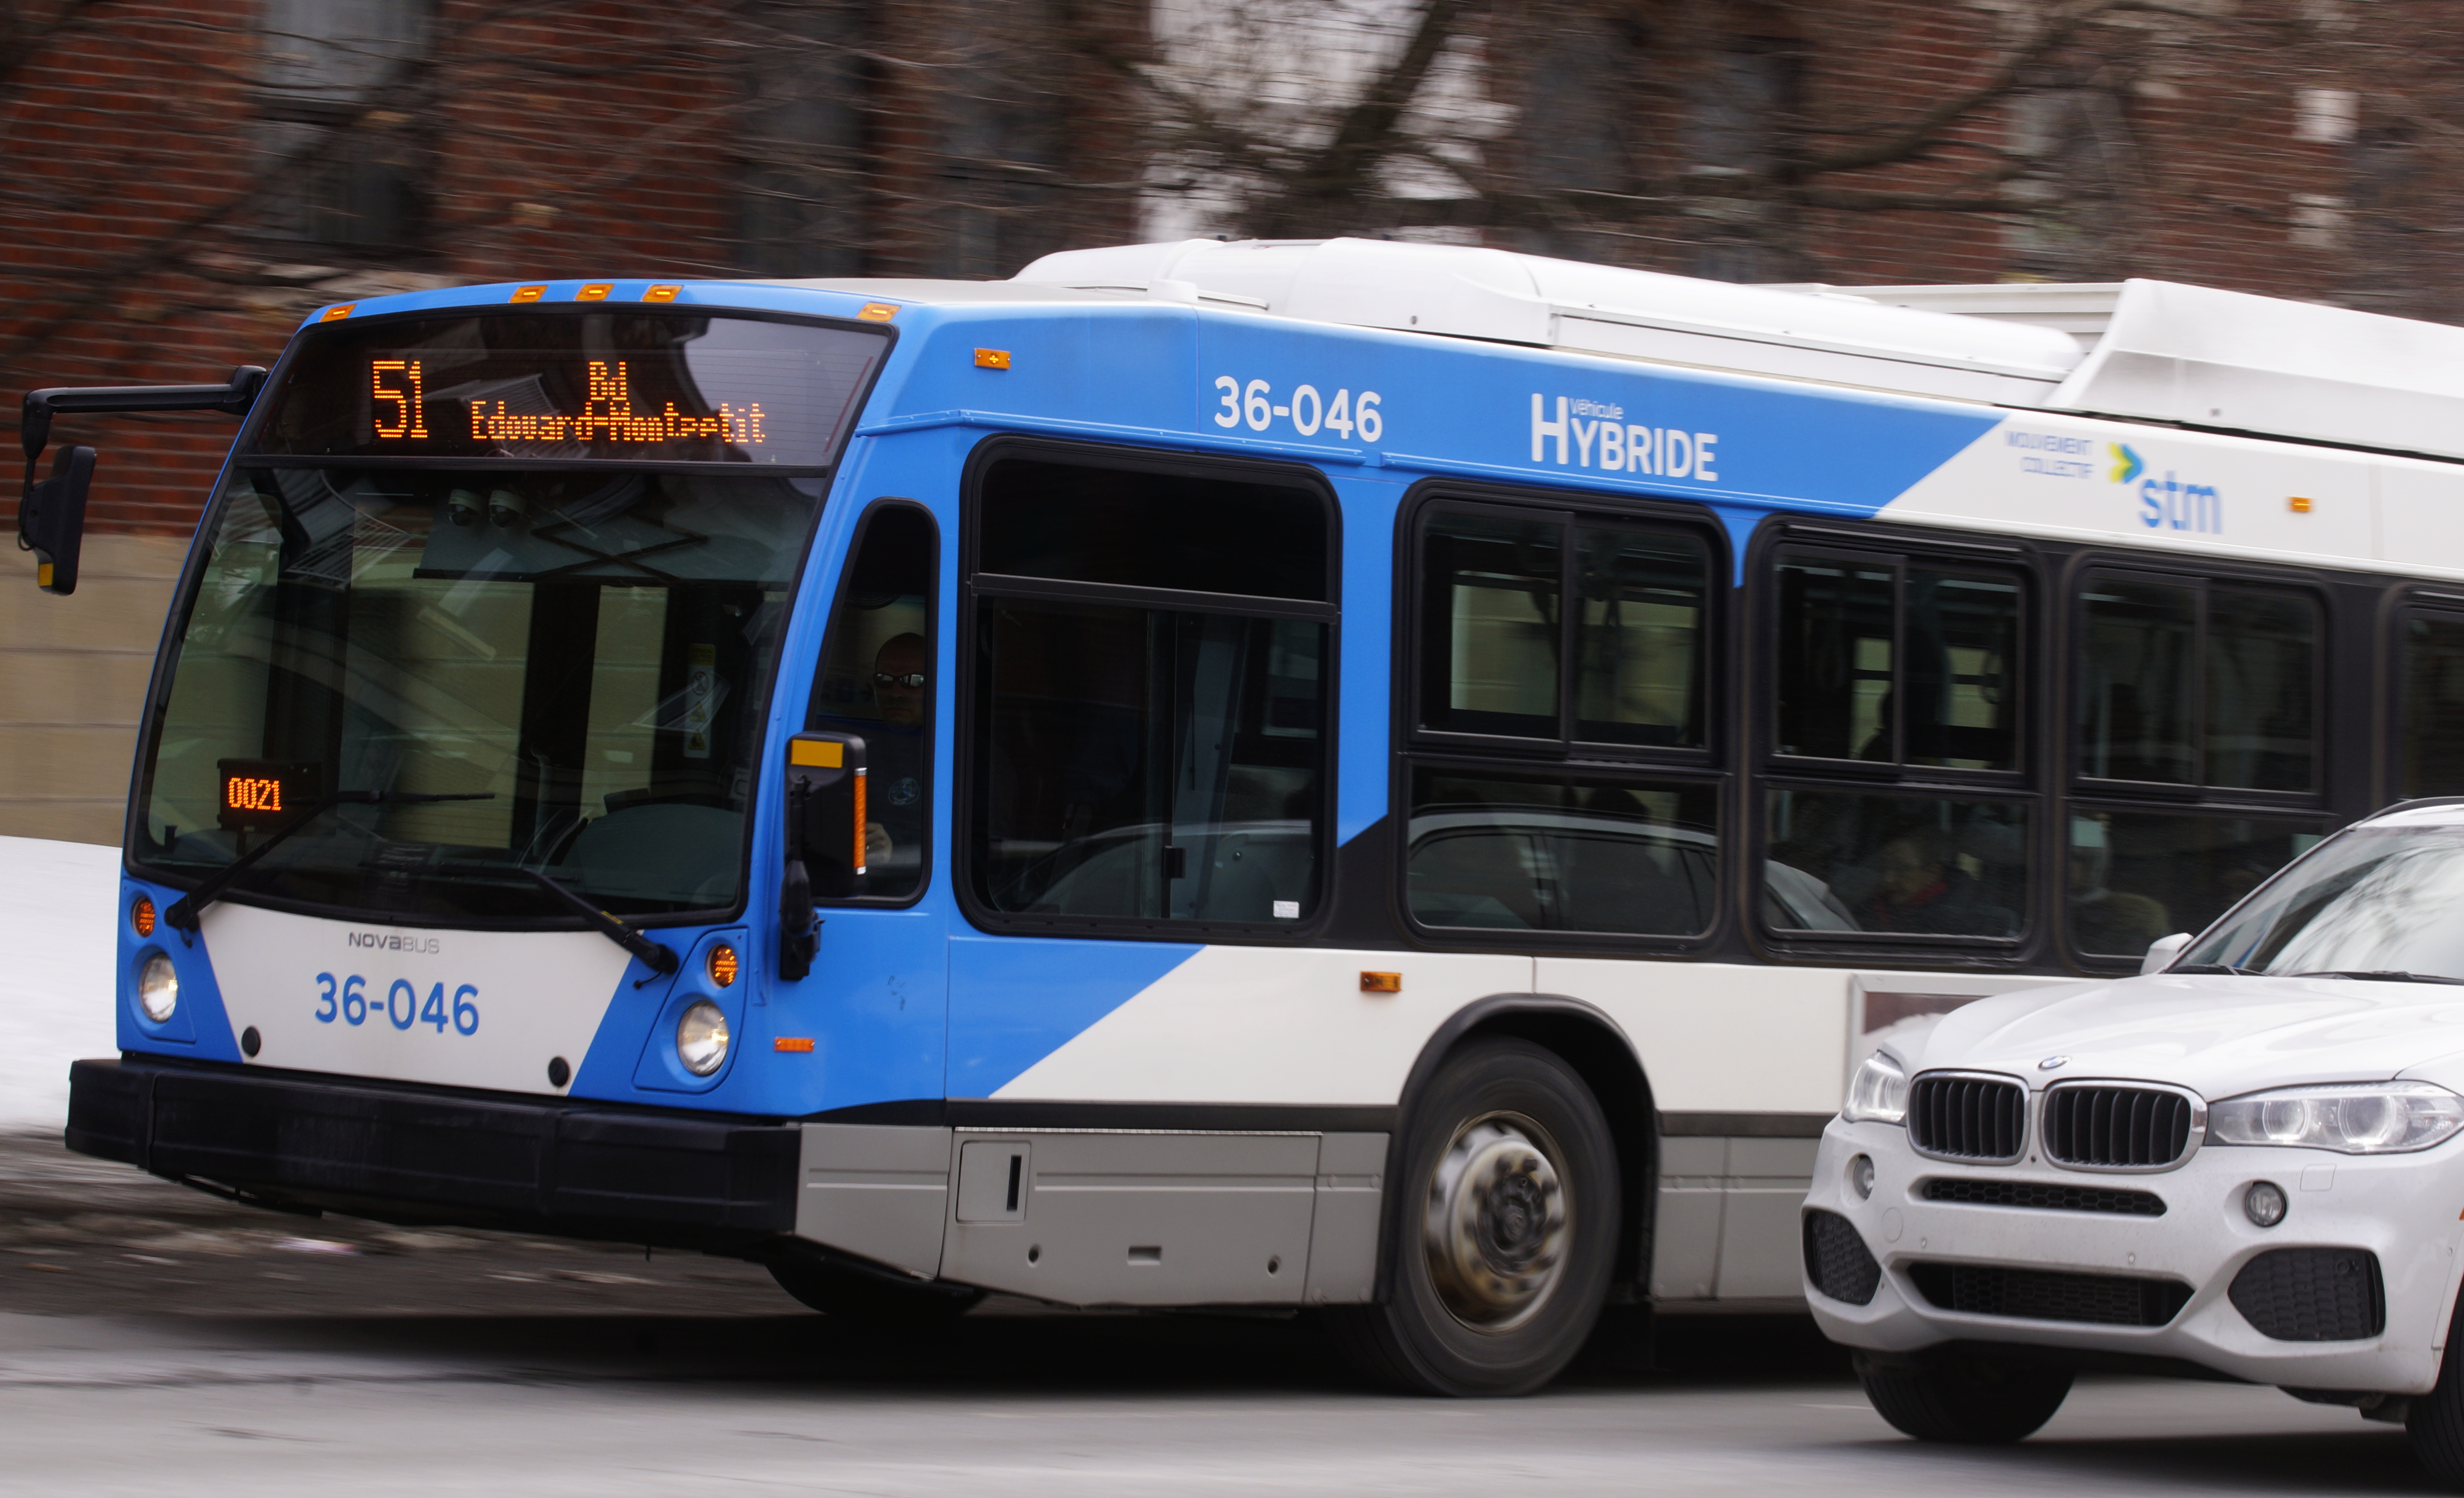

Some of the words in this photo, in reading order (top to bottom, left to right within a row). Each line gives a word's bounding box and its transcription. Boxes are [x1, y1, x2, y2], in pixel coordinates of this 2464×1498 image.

[373, 360, 428, 437] 51
[589, 361, 626, 400] Bd
[1214, 376, 1382, 442] 36-046
[1531, 393, 1718, 481] HYBRIDE
[2140, 471, 2223, 534] stm
[228, 777, 281, 811] 0021
[315, 971, 479, 1037] 36-046
